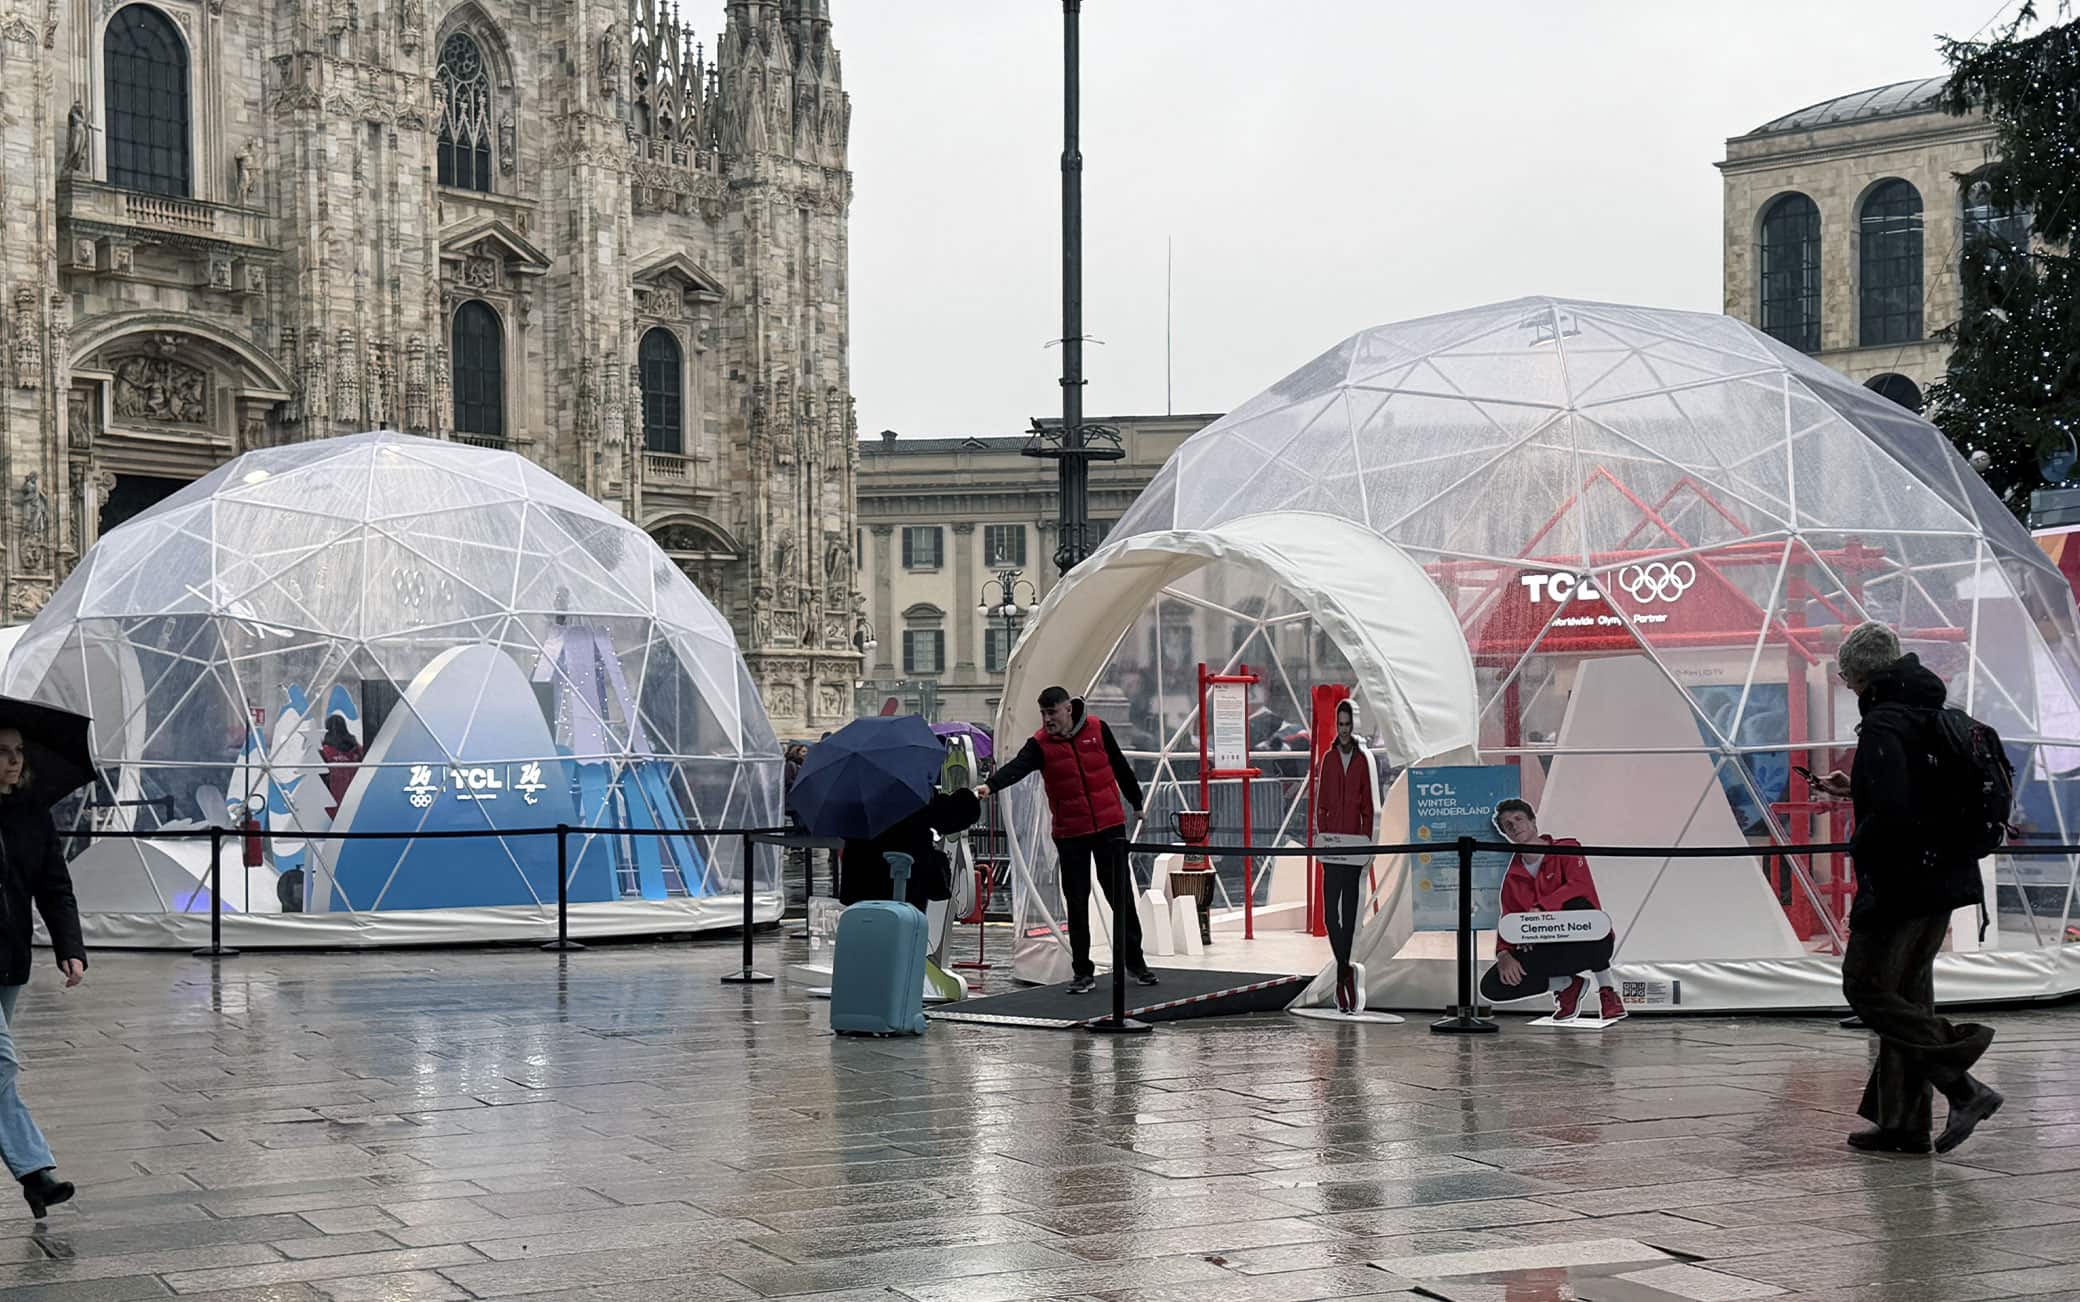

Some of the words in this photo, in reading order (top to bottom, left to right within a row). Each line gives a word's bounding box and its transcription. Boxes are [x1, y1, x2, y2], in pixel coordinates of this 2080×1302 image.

[1521, 572, 1600, 602] TCL
[450, 768, 503, 789] TCL
[1416, 783, 1456, 796] TCL
[1417, 799, 1456, 807] WINTER
[1417, 807, 1490, 816] WONDERLAND
[1520, 914, 1540, 922] Team
[1521, 924, 1565, 933] Clement
